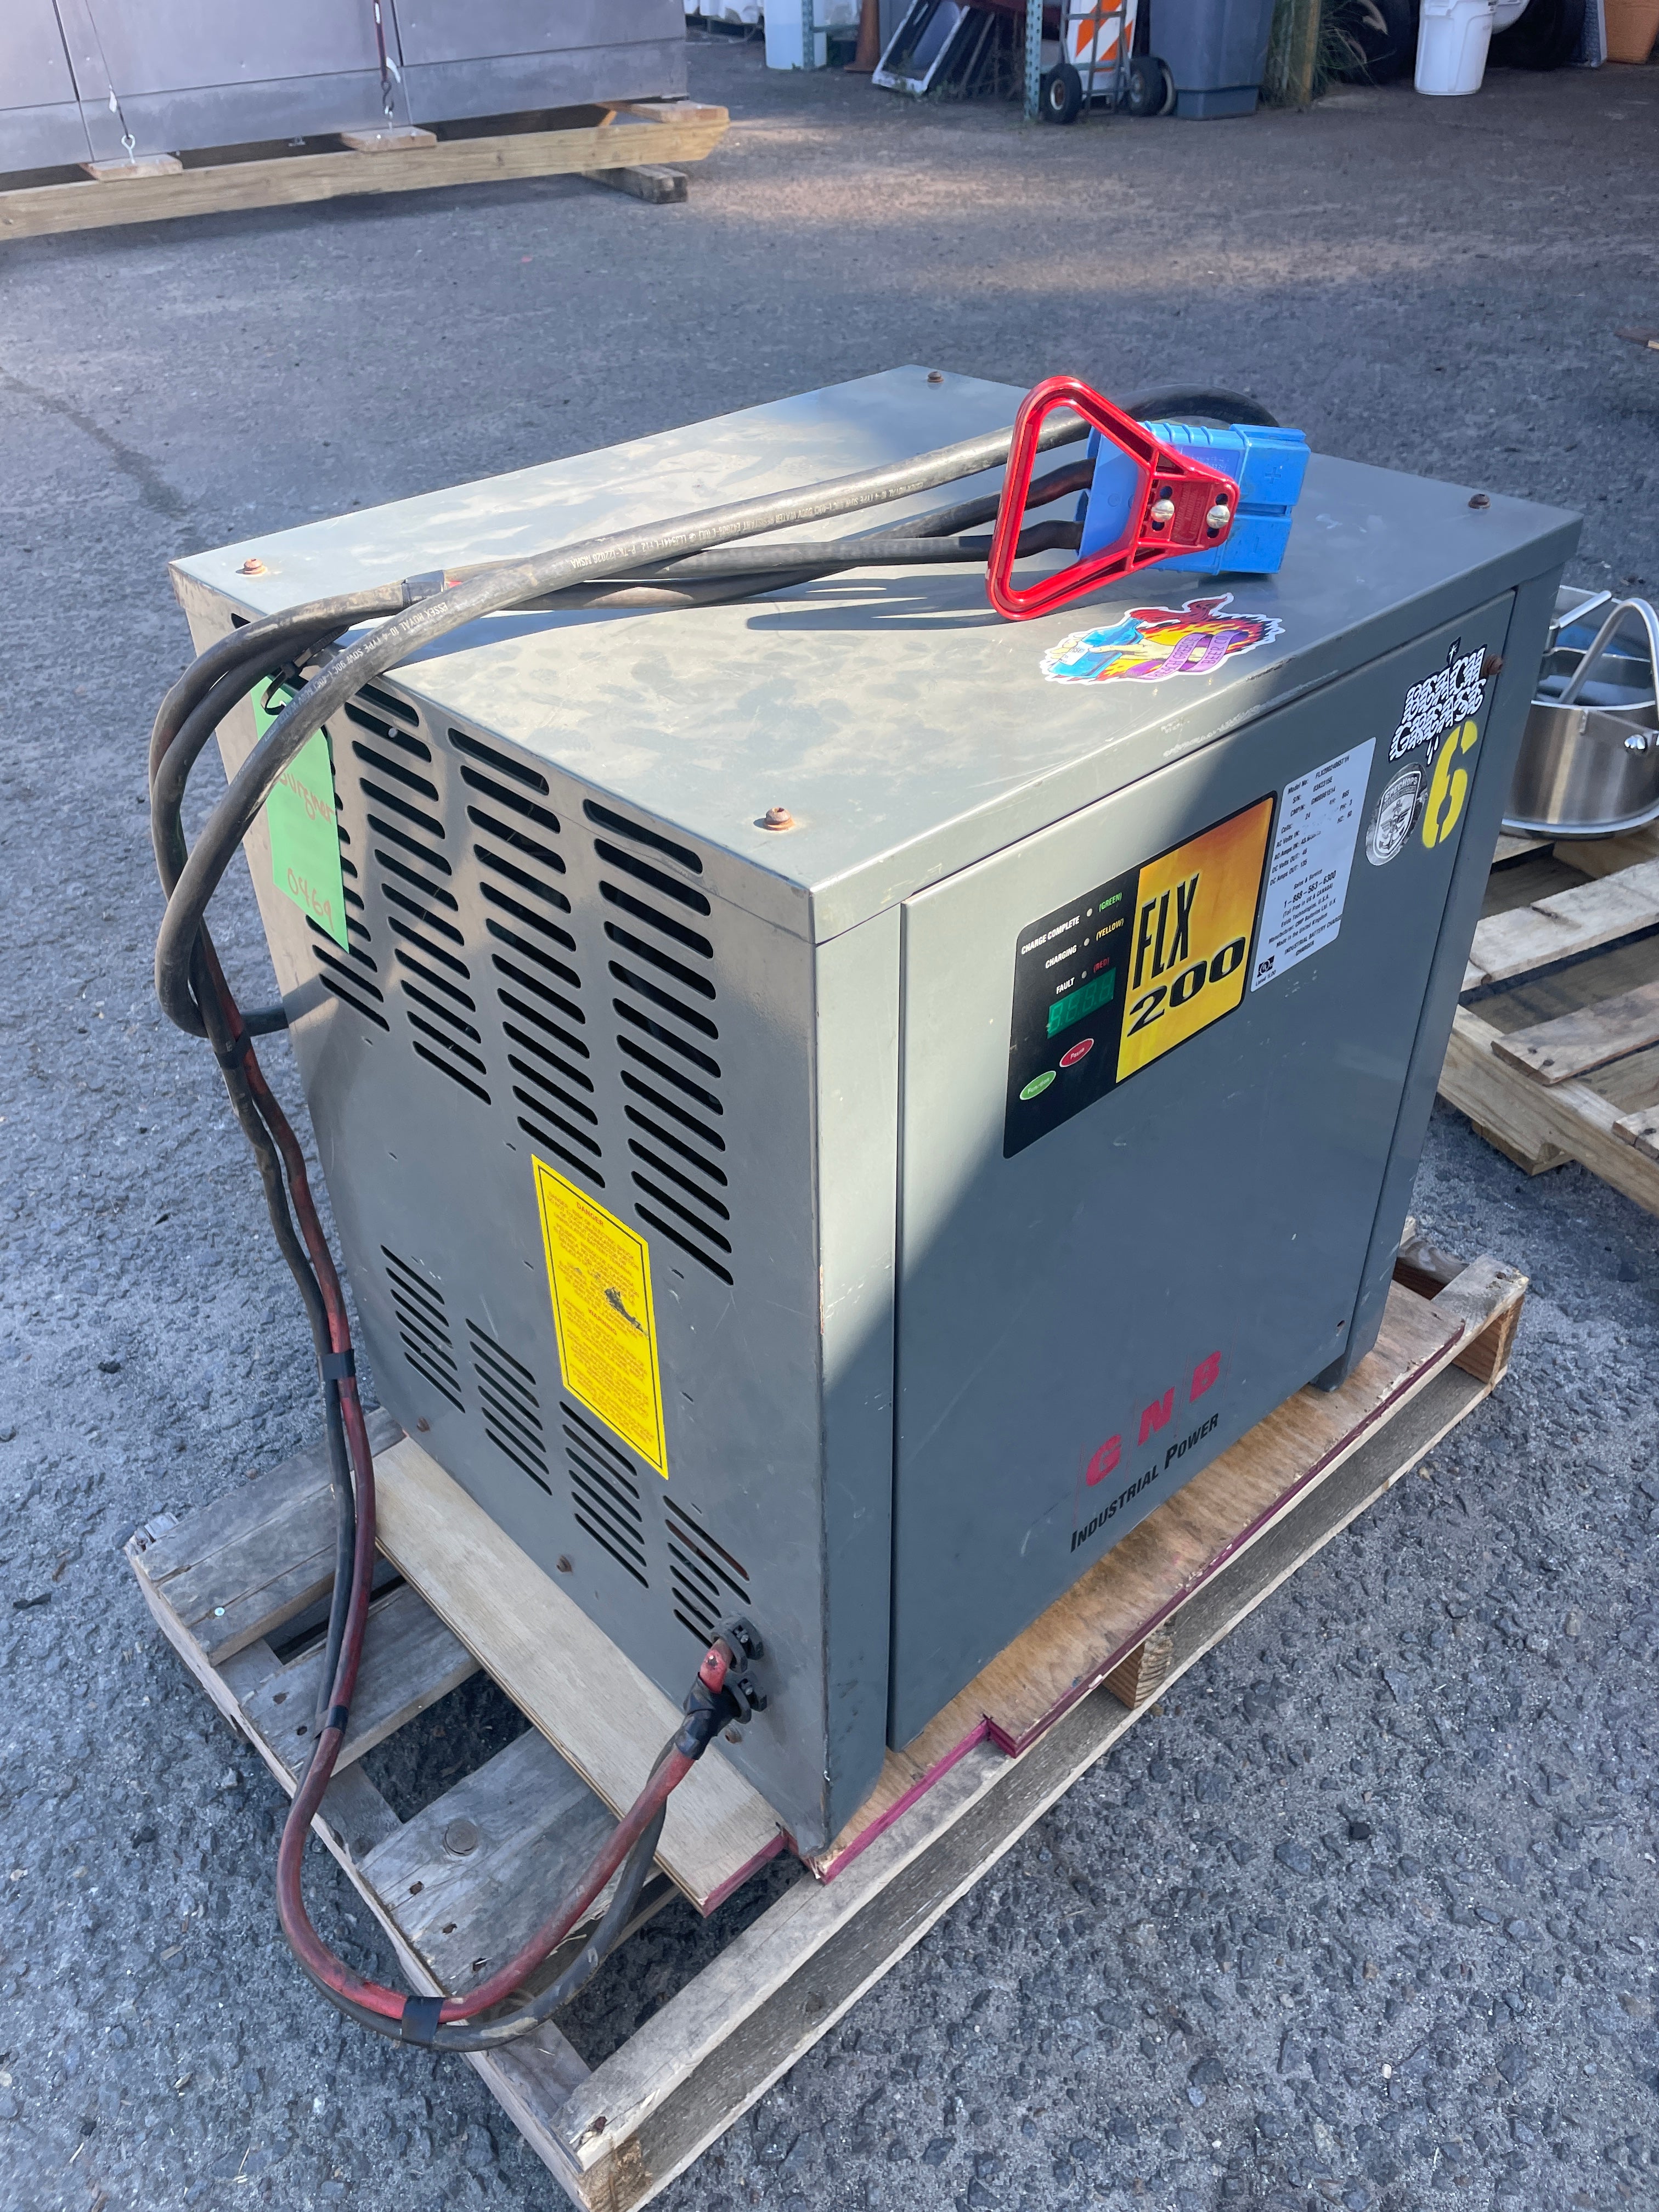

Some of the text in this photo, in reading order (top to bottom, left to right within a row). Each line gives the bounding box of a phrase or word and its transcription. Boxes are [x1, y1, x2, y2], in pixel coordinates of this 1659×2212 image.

[569, 555, 591, 568] MSHA
[399, 613, 423, 628] ROYAL
[425, 601, 448, 618] ESSEX
[364, 637, 381, 650] TYPE
[1201, 636, 1229, 664] BEER CO
[1147, 637, 1199, 678] BEACH GREASE
[1402, 647, 1486, 723] BEACH
[1389, 679, 1487, 761] GREASE
[1288, 783, 1301, 794] Model
[1421, 720, 1478, 849] 6
[1099, 892, 1122, 912] (GREEN)
[1021, 916, 1080, 955] CHARGE COMPLETE
[1096, 918, 1124, 941] (YELLOW)
[1133, 872, 1200, 990] FLX
[1309, 924, 1326, 939] BATTERY
[1277, 938, 1287, 947] Made
[1045, 945, 1077, 968] CHARGING
[1093, 957, 1110, 973] (RED)
[1056, 977, 1075, 995] FAULT
[1127, 936, 1246, 1037] 200
[575, 1200, 604, 1228] DANGER
[588, 1306, 617, 1336] WARNING
[1086, 1351, 1222, 1487] GNB
[1070, 1413, 1219, 1553] INDUSTRIAL POWER
